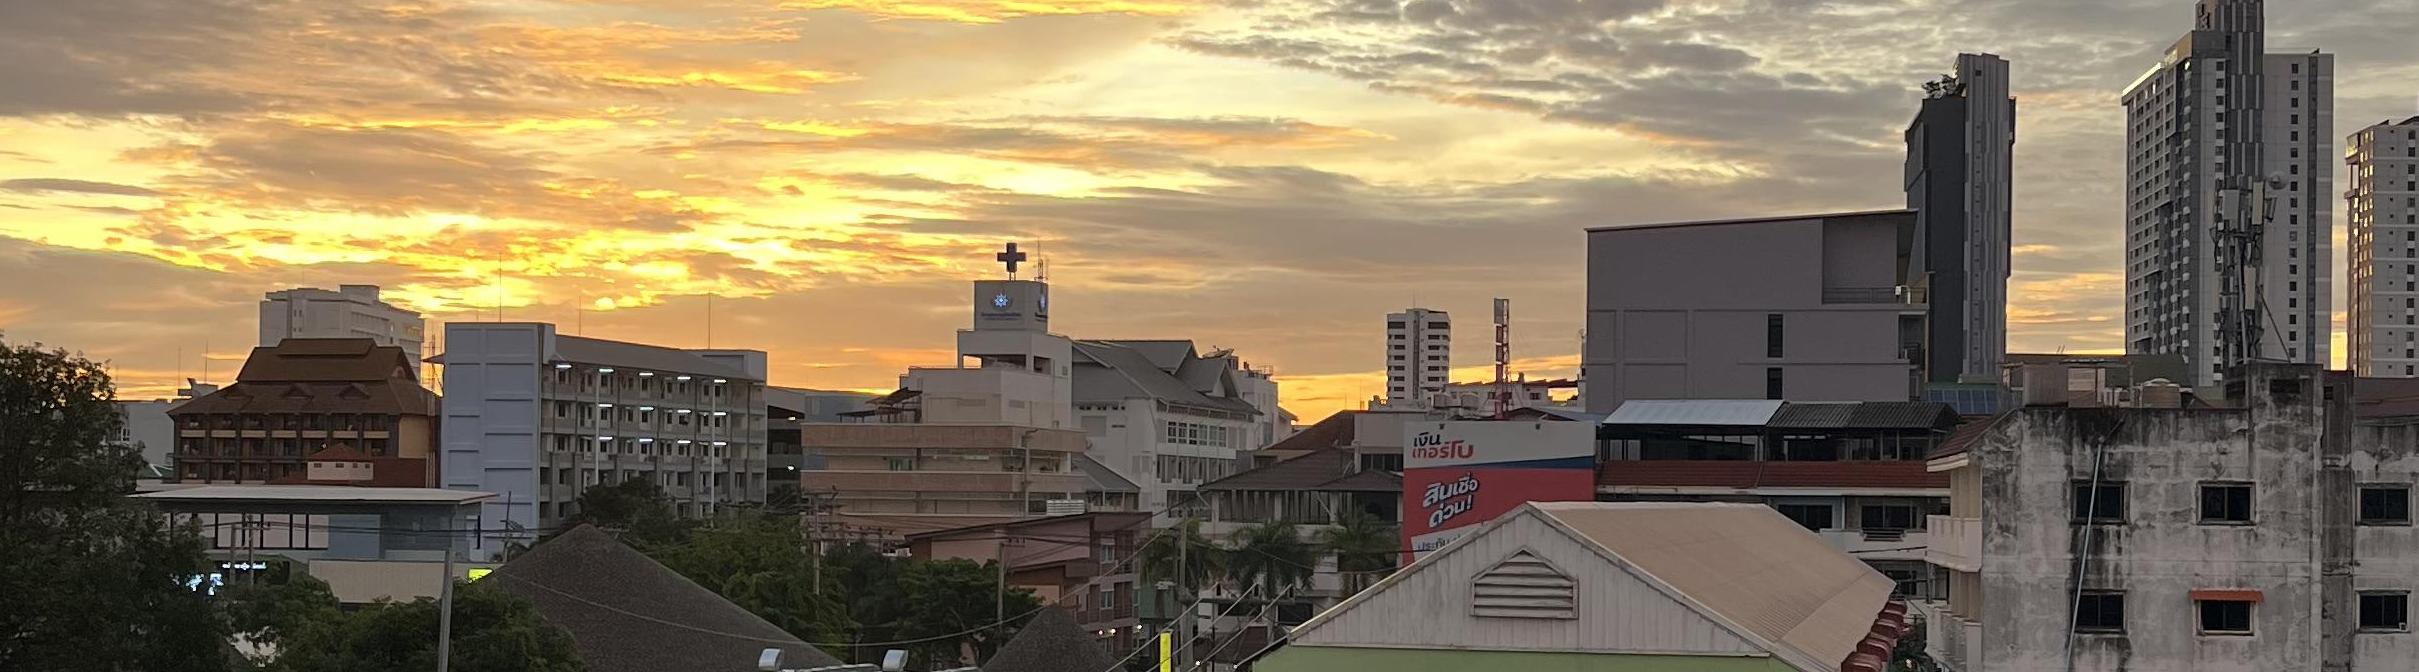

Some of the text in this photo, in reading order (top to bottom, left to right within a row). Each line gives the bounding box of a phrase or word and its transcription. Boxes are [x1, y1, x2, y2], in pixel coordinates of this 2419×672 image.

[1414, 432, 1441, 447] เงิน
[1422, 472, 1479, 507] สินเชื่อ
[1428, 494, 1472, 528] ด่วน!
